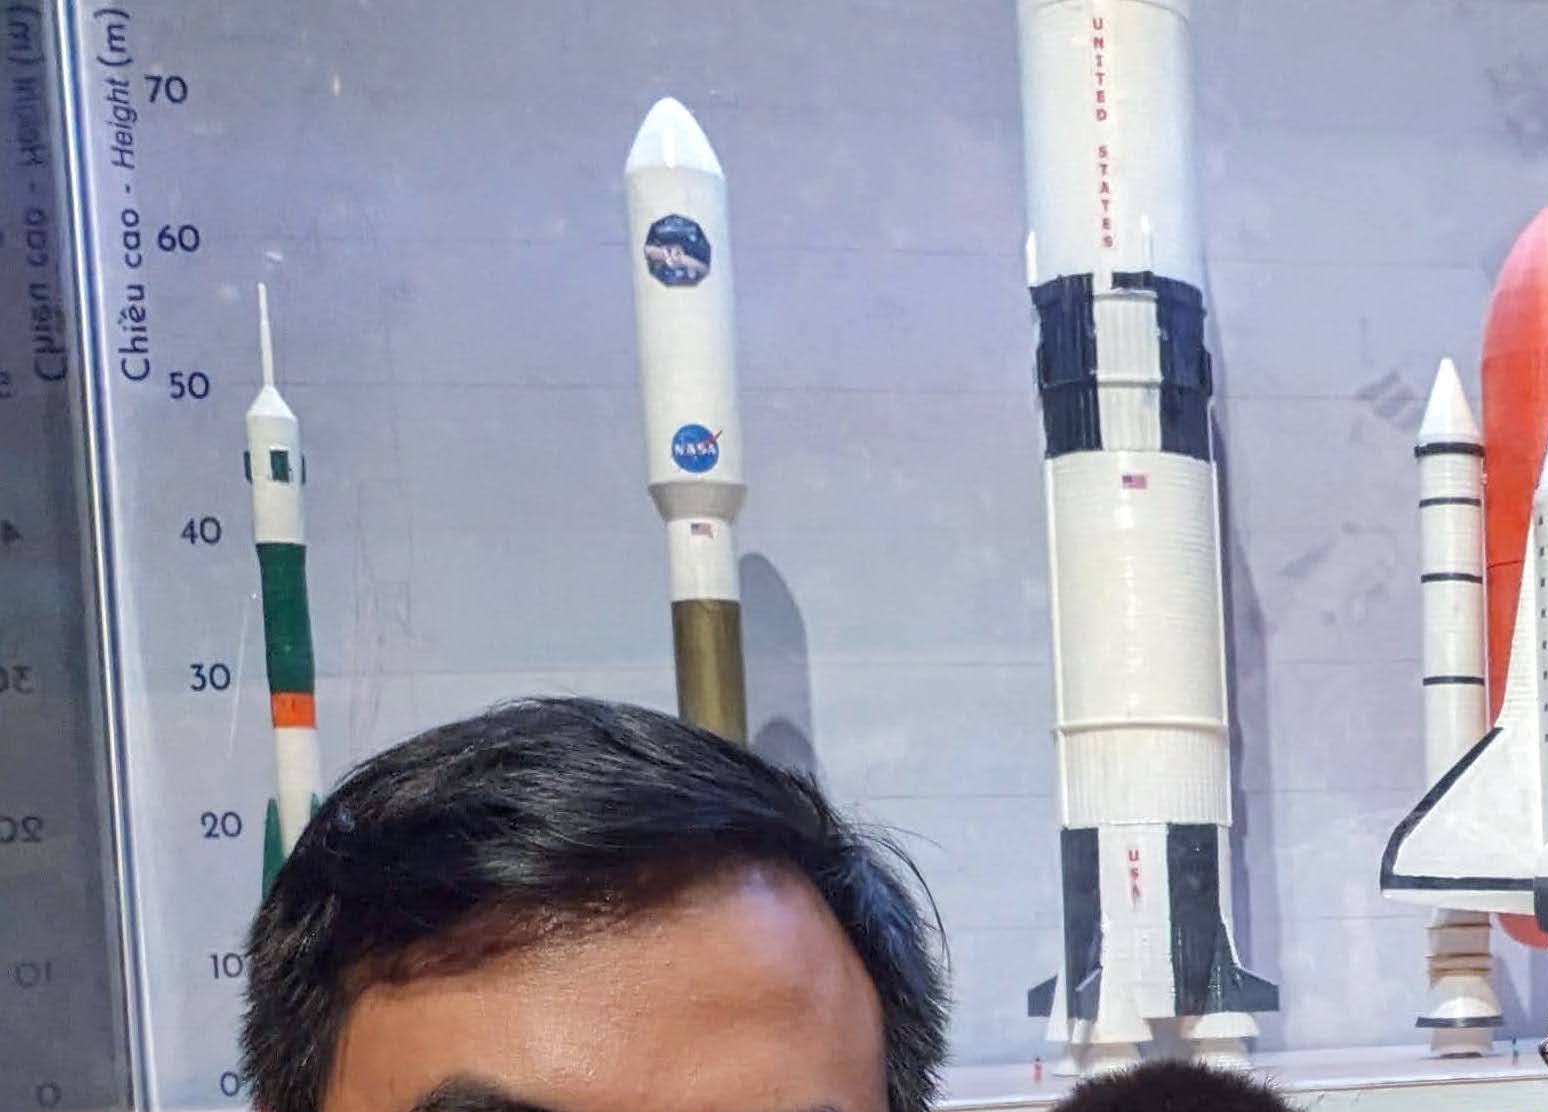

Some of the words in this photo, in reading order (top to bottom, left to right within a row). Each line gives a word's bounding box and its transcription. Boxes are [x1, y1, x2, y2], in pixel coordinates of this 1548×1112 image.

[93, 8, 133, 66] (m)
[1092, 17, 1108, 121] UNITED
[144, 74, 188, 104] 70
[104, 78, 138, 169] Height
[1098, 145, 1114, 248] STATES
[121, 208, 143, 268] cao
[157, 224, 200, 252] 60
[118, 284, 150, 381] Chiều
[168, 371, 210, 400] 50
[674, 442, 718, 457] NASA
[180, 516, 222, 545] 40
[189, 663, 231, 692] 30
[200, 811, 243, 839] 20
[1128, 849, 1141, 897] USA
[209, 953, 243, 979] 10
[220, 1071, 241, 1097] 0
